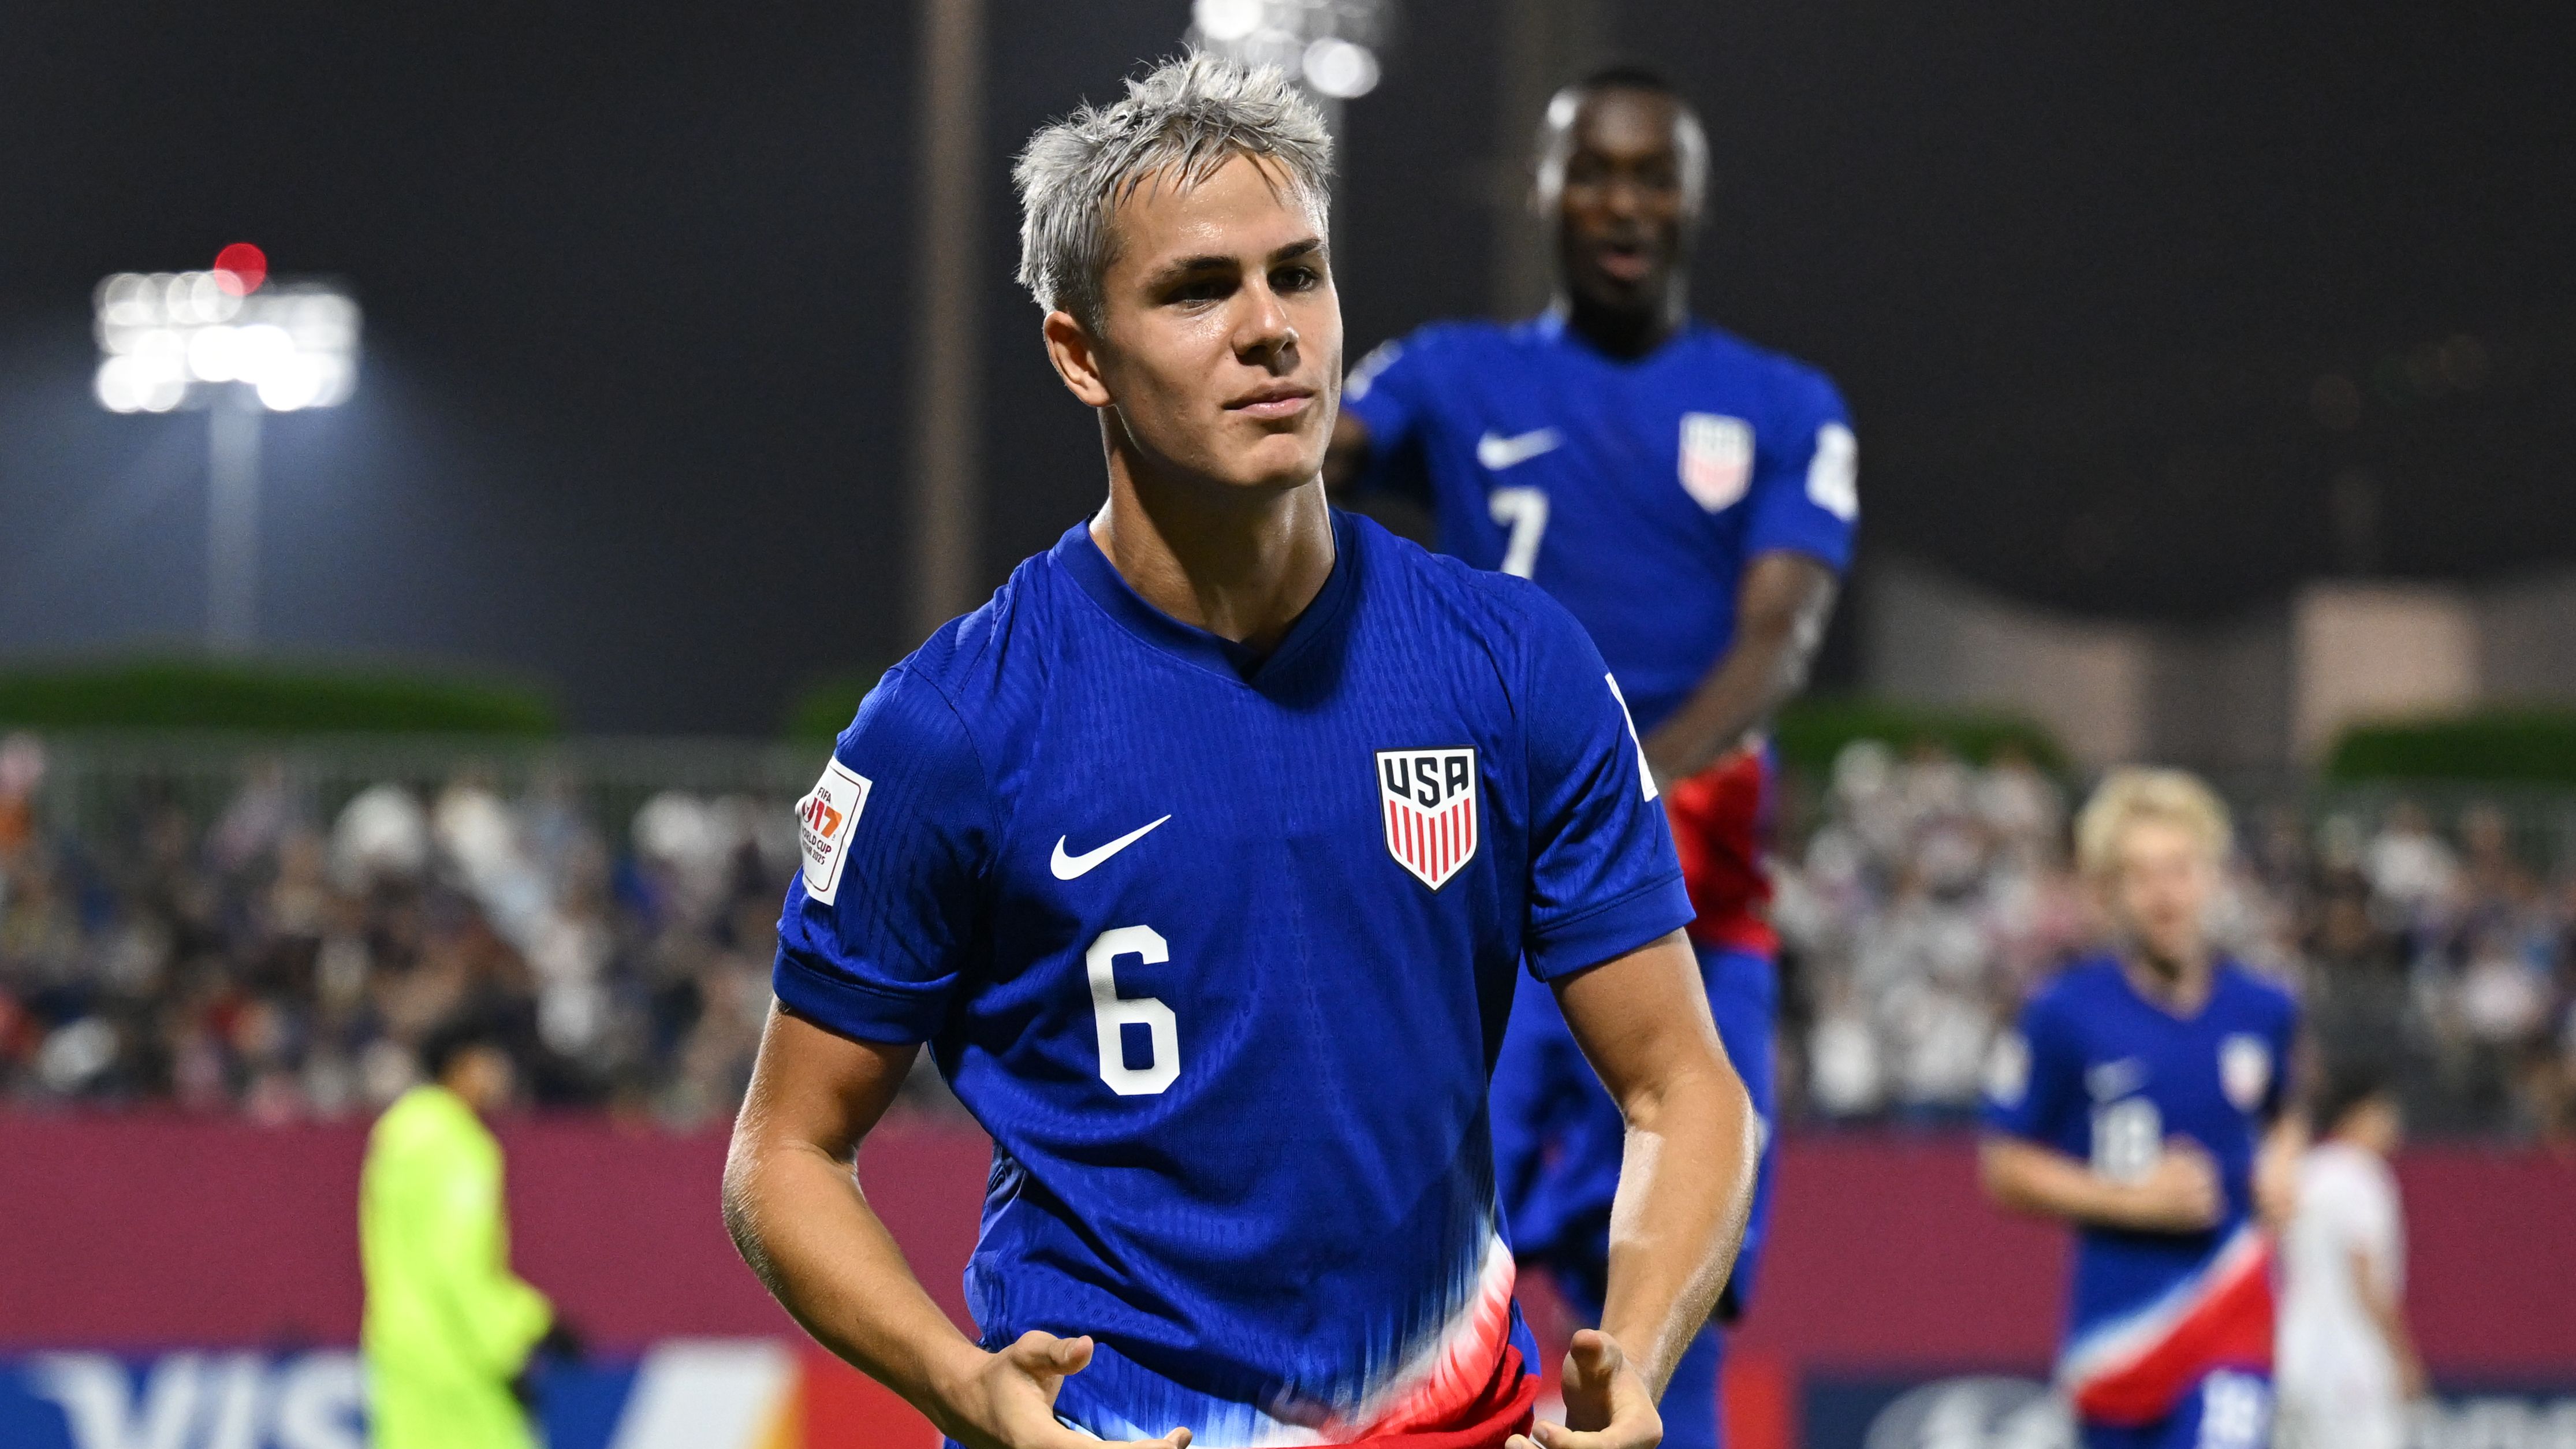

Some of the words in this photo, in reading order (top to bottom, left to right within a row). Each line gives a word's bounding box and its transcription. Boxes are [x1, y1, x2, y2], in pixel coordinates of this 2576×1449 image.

[1488, 485, 1550, 579] 7
[817, 787, 832, 803] FIFA
[1384, 756, 1468, 808] USA
[801, 797, 842, 839] U17
[812, 850, 826, 865] 2025
[817, 840, 832, 854] CUP
[1086, 924, 1180, 1096] 6
